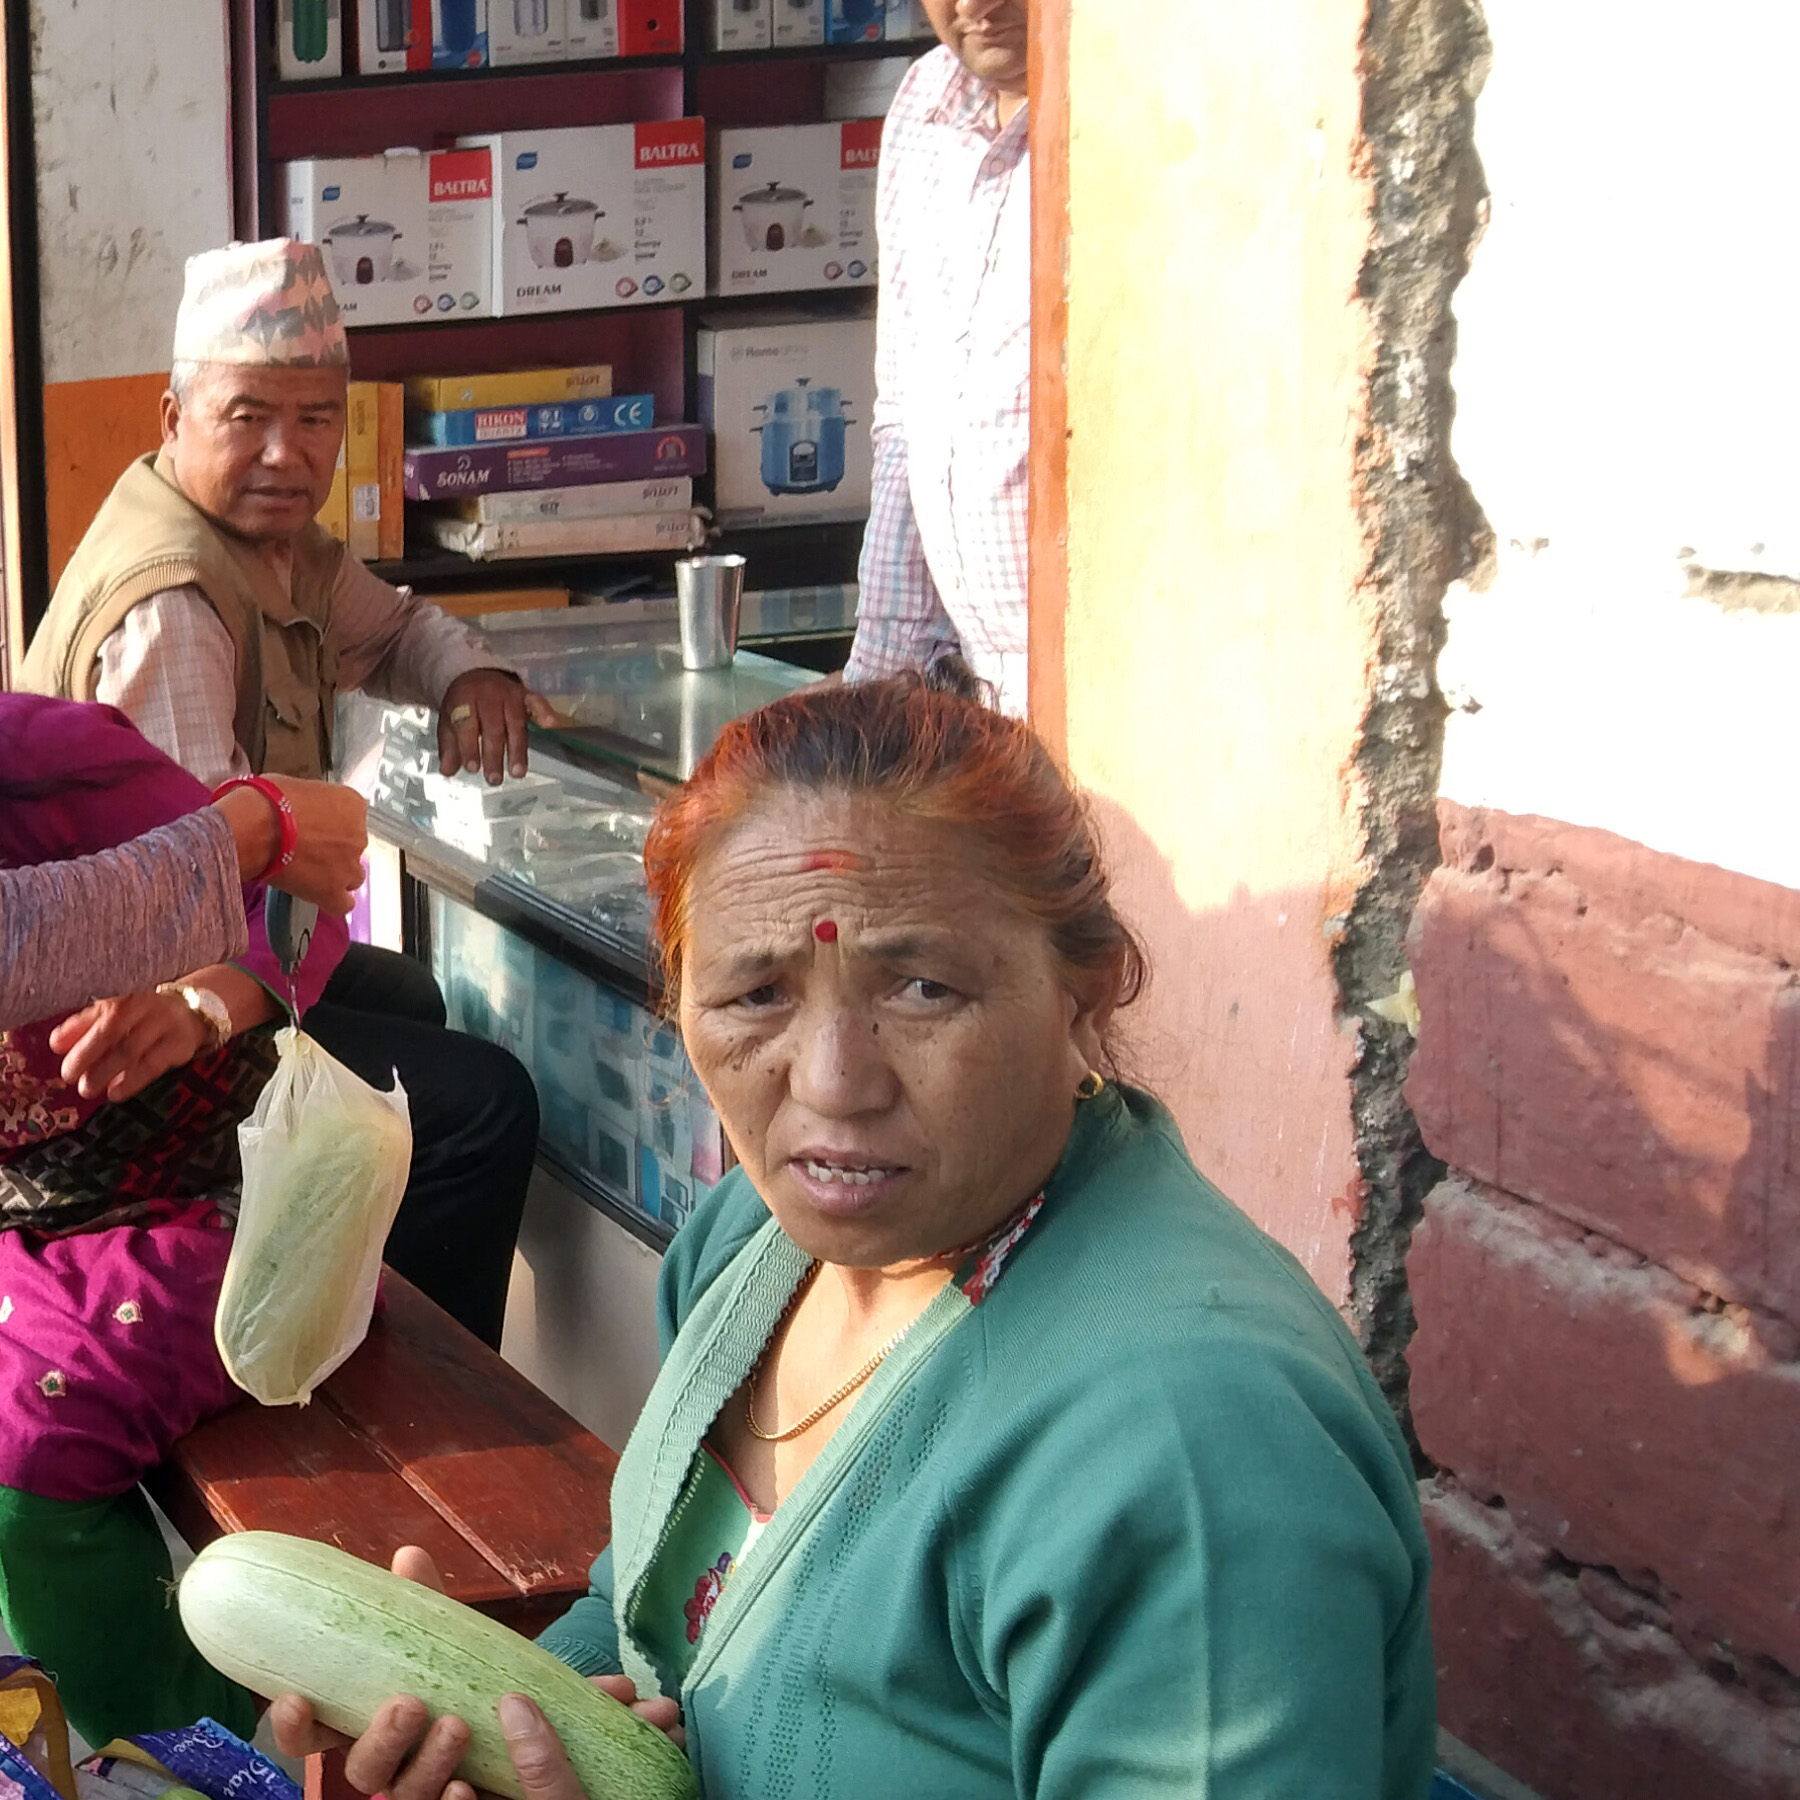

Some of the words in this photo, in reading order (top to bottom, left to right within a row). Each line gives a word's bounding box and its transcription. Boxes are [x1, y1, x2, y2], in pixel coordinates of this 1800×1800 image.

[640, 143, 700, 162] BALTRA
[434, 178, 488, 197] BALTRA
[516, 284, 562, 299] DREAM
[338, 301, 358, 312] AM
[477, 411, 526, 428] RIKON
[613, 402, 642, 427] CE
[436, 469, 491, 488] SONAM
